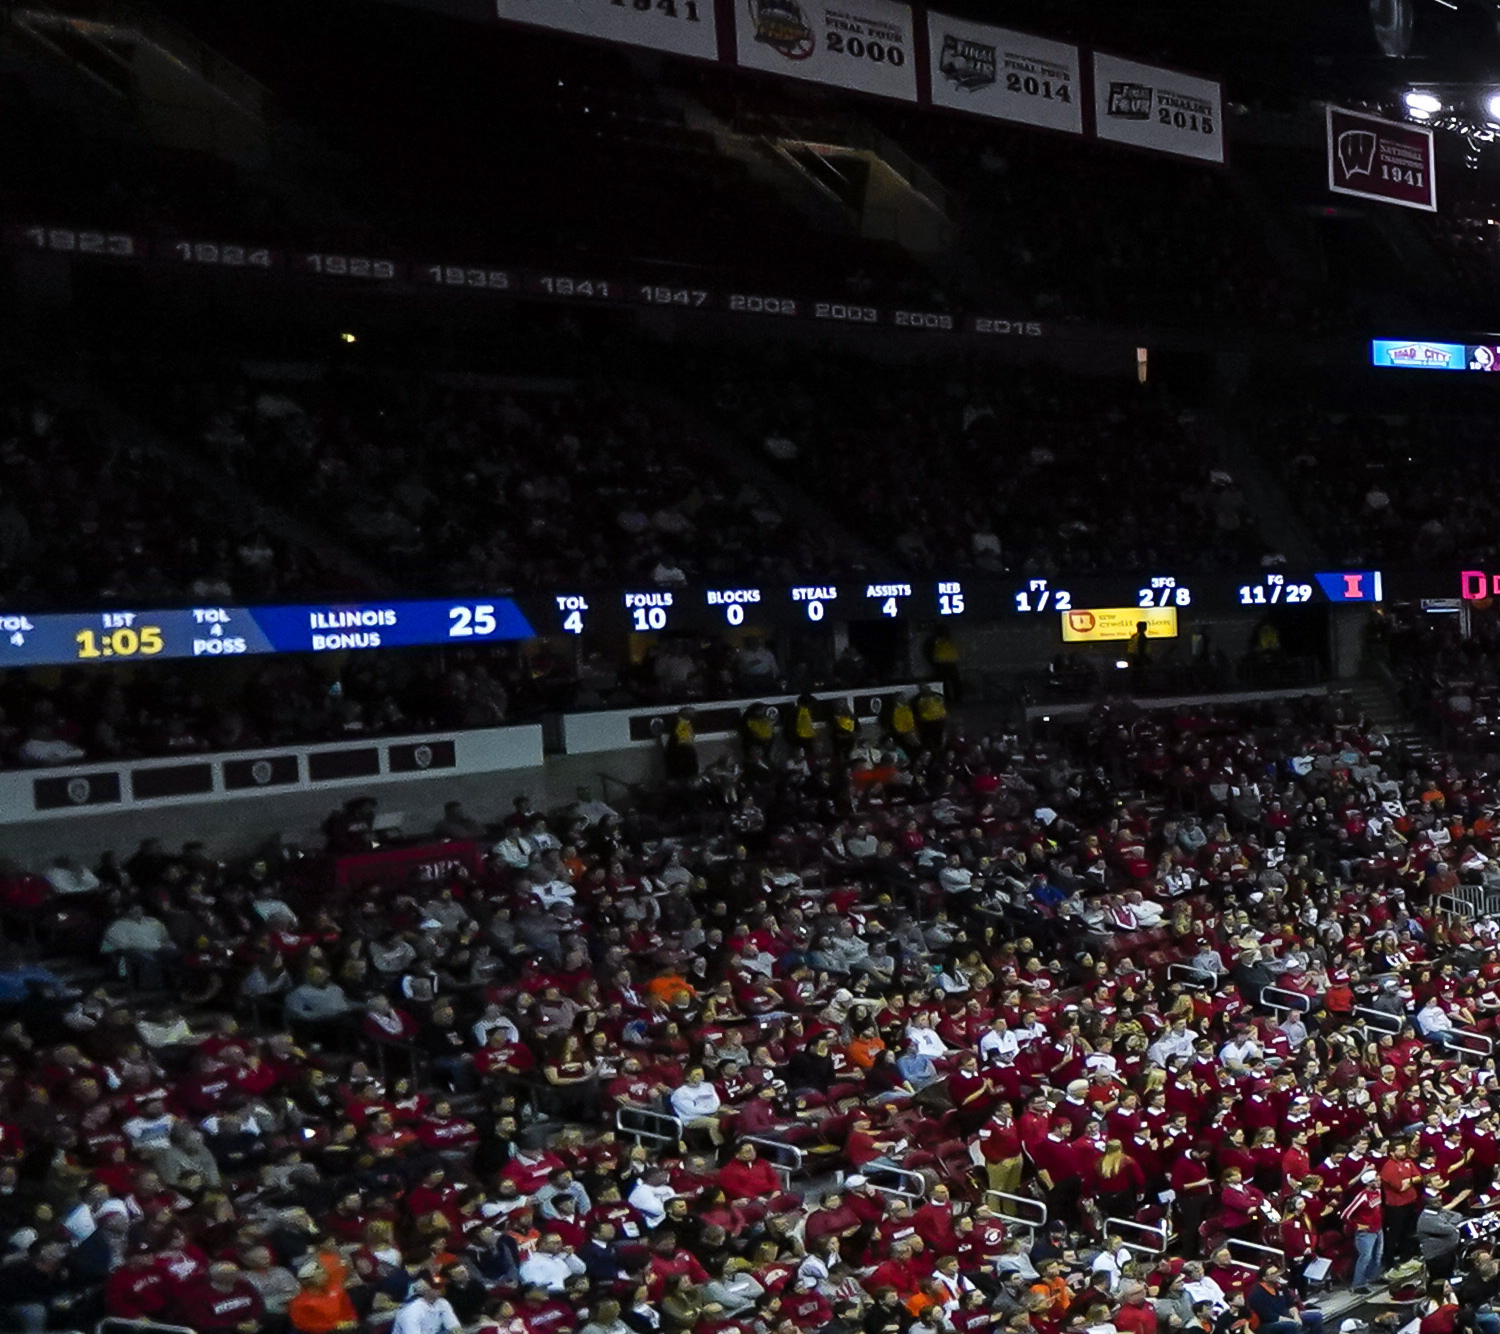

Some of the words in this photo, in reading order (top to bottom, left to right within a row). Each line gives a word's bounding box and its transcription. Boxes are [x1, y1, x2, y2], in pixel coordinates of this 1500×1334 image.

[825, 32, 905, 67] 2000
[1006, 72, 1072, 104] 2014
[1158, 108, 1213, 135] 2015
[1381, 165, 1424, 187] 1941
[538, 275, 610, 298] 1941
[639, 284, 709, 307] 1947
[729, 293, 797, 315] 2002
[813, 302, 879, 323] 2003
[938, 582, 961, 595] REB
[1029, 579, 1047, 592] FT
[1151, 577, 1176, 589] 3FG
[1267, 574, 1284, 586] FG
[707, 590, 761, 604] BLOCKS
[792, 587, 837, 601] STEALS
[866, 584, 912, 597] ASSISTS
[556, 596, 589, 610] TOL
[625, 593, 673, 608] FOULS
[883, 598, 898, 617] 4
[939, 595, 964, 614] 15
[102, 612, 137, 628] 1ST
[193, 608, 232, 623] TOL
[310, 609, 397, 630] ILLINOIS
[449, 604, 497, 637] 25
[633, 608, 667, 631] 10
[727, 604, 744, 625] 0
[808, 601, 824, 621] 0
[209, 623, 223, 637] 4
[563, 611, 584, 634] 4
[10, 631, 25, 647] 4
[76, 626, 164, 658] 1:05
[193, 637, 248, 656] POSS
[312, 631, 382, 651] BONUS
